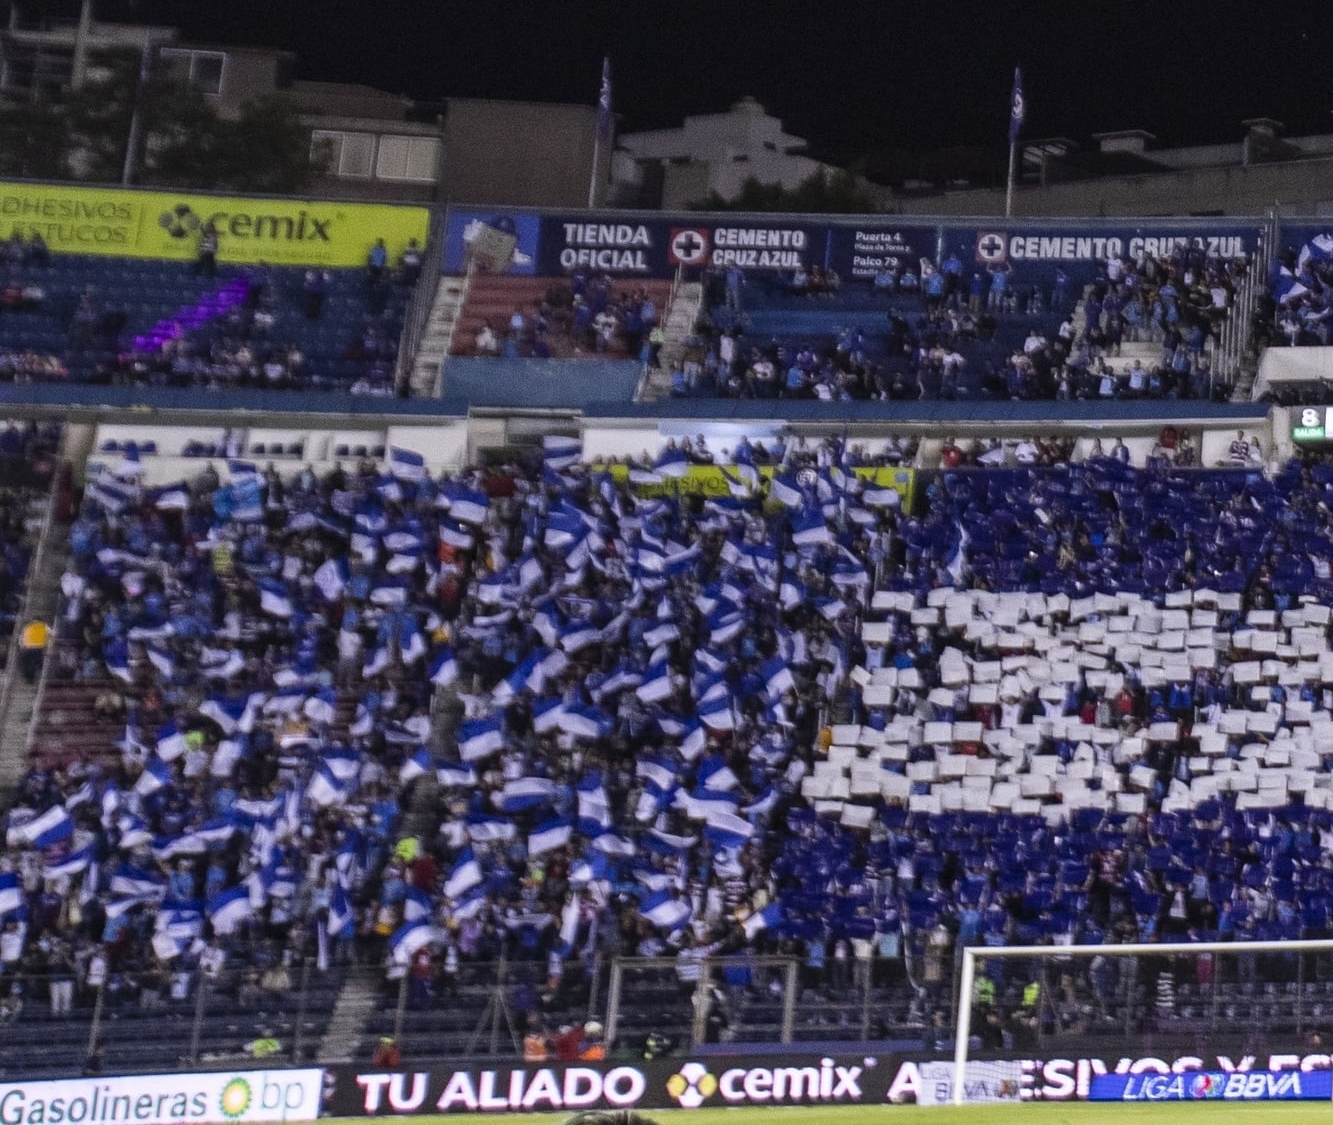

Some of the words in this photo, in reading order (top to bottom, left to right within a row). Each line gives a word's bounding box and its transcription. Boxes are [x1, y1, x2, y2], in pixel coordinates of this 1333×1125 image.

[562, 223, 650, 246] TIENDA
[714, 227, 805, 247] CEMENTO
[855, 231, 891, 242] Puerta
[893, 232, 901, 242] 4
[560, 248, 648, 269] OFICIAL
[712, 249, 758, 267] CRUZ
[759, 250, 802, 267] AZUL
[1009, 236, 1123, 259] CEMENTO
[853, 255, 882, 271] Palco
[884, 256, 898, 271] 79
[1301, 408, 1320, 427] 8
[357, 1072, 429, 1113] TU
[436, 1066, 647, 1109] ALIADO
[719, 1057, 863, 1101] cemix
[1123, 1075, 1185, 1099] LIGA
[1223, 1071, 1302, 1098] BBVA
[0, 1083, 208, 1125] Gasolineras
[261, 1073, 305, 1121] bp
